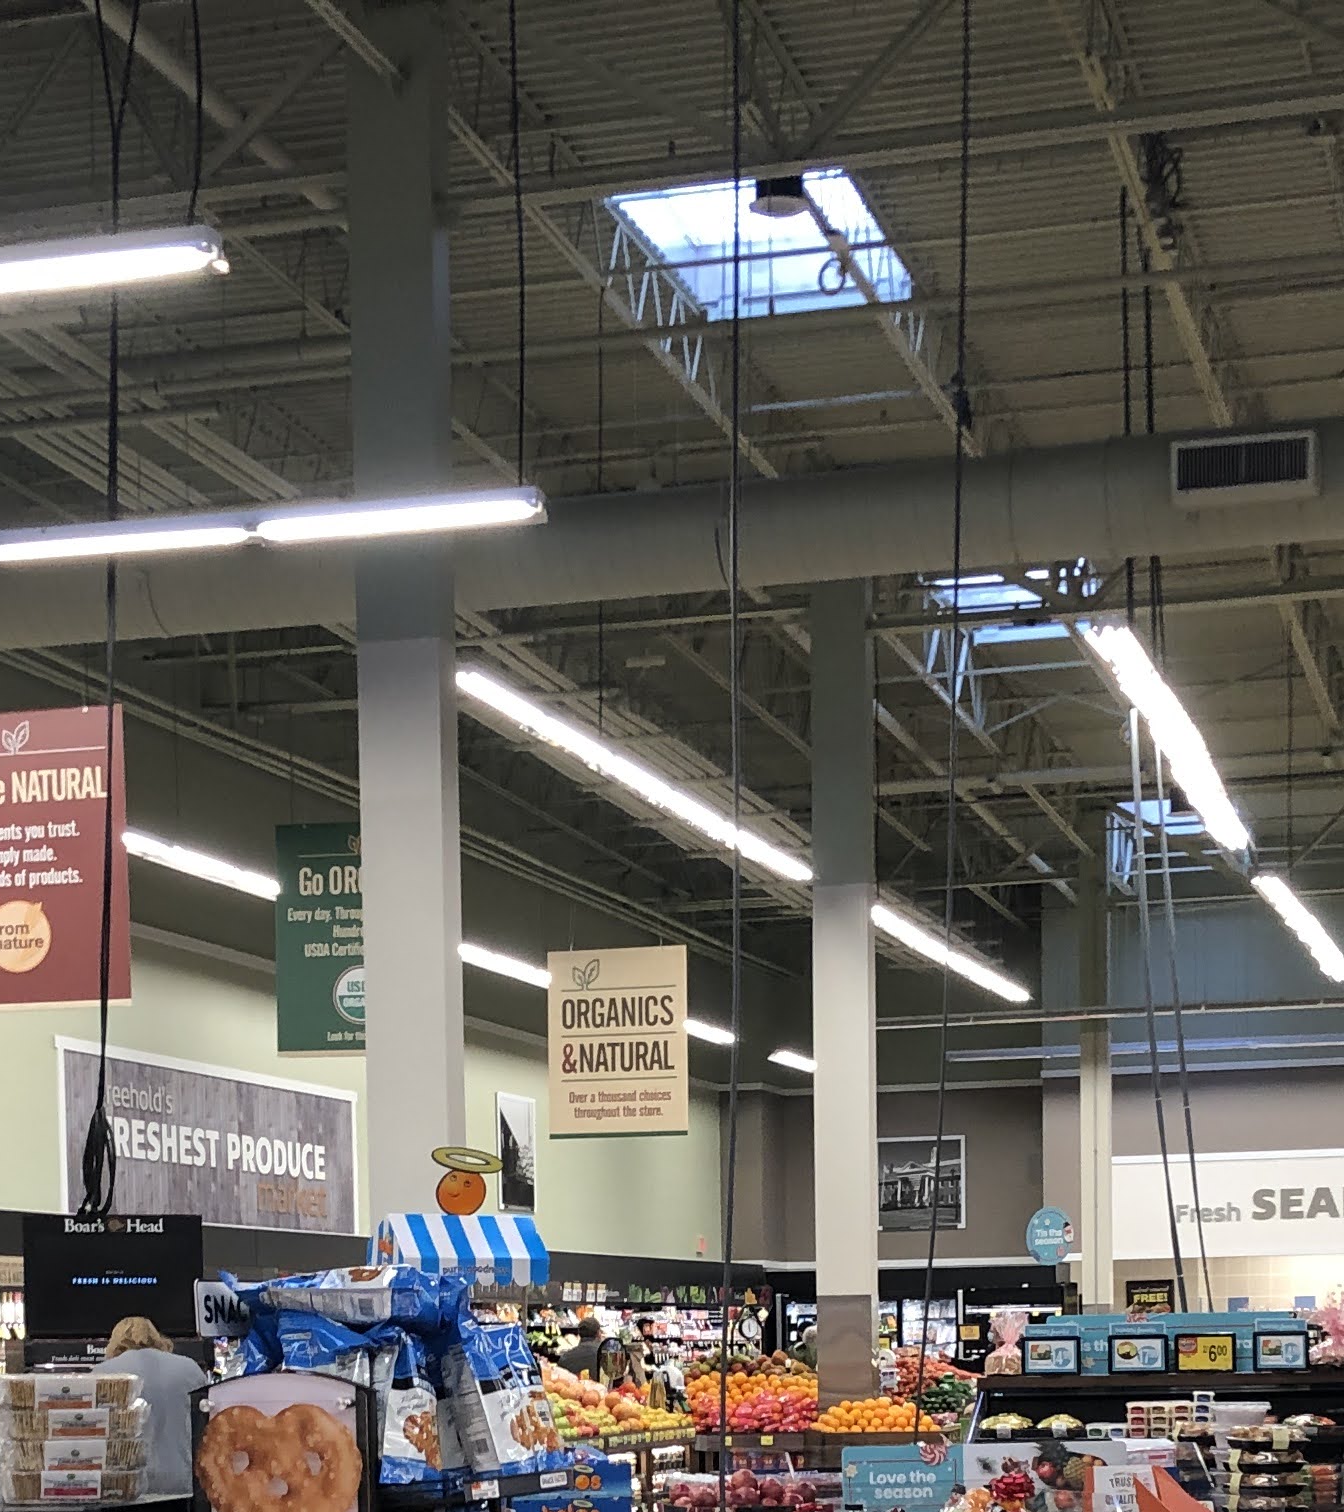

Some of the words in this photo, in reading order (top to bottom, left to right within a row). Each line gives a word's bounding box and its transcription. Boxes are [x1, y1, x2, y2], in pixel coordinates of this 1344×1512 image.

[11, 766, 107, 804] NATURAL
[25, 825, 45, 842] you
[48, 820, 80, 837] trust.
[22, 845, 57, 862] made.
[14, 869, 26, 886] of
[29, 867, 83, 889] products.
[299, 867, 323, 896] Go
[287, 908, 312, 923] Every
[305, 943, 329, 957] USDA
[562, 995, 674, 1029] ORGANICS
[105, 1082, 174, 1115] reehold's
[569, 1092, 587, 1104] Over
[589, 1093, 596, 1104] a
[598, 1091, 636, 1103] thousand
[639, 1090, 671, 1102] choices
[574, 1106, 620, 1120] throughout
[623, 1106, 636, 1117] the
[639, 1106, 663, 1117] store.
[227, 1133, 327, 1181] PRODUCE
[257, 1181, 329, 1218] market
[1175, 1202, 1241, 1224] Fresh
[64, 1217, 105, 1233] Boar's
[126, 1217, 164, 1233] Head
[442, 1265, 465, 1276] pure
[869, 1470, 907, 1485] Love
[909, 1468, 937, 1485] the
[874, 1484, 933, 1499] season
